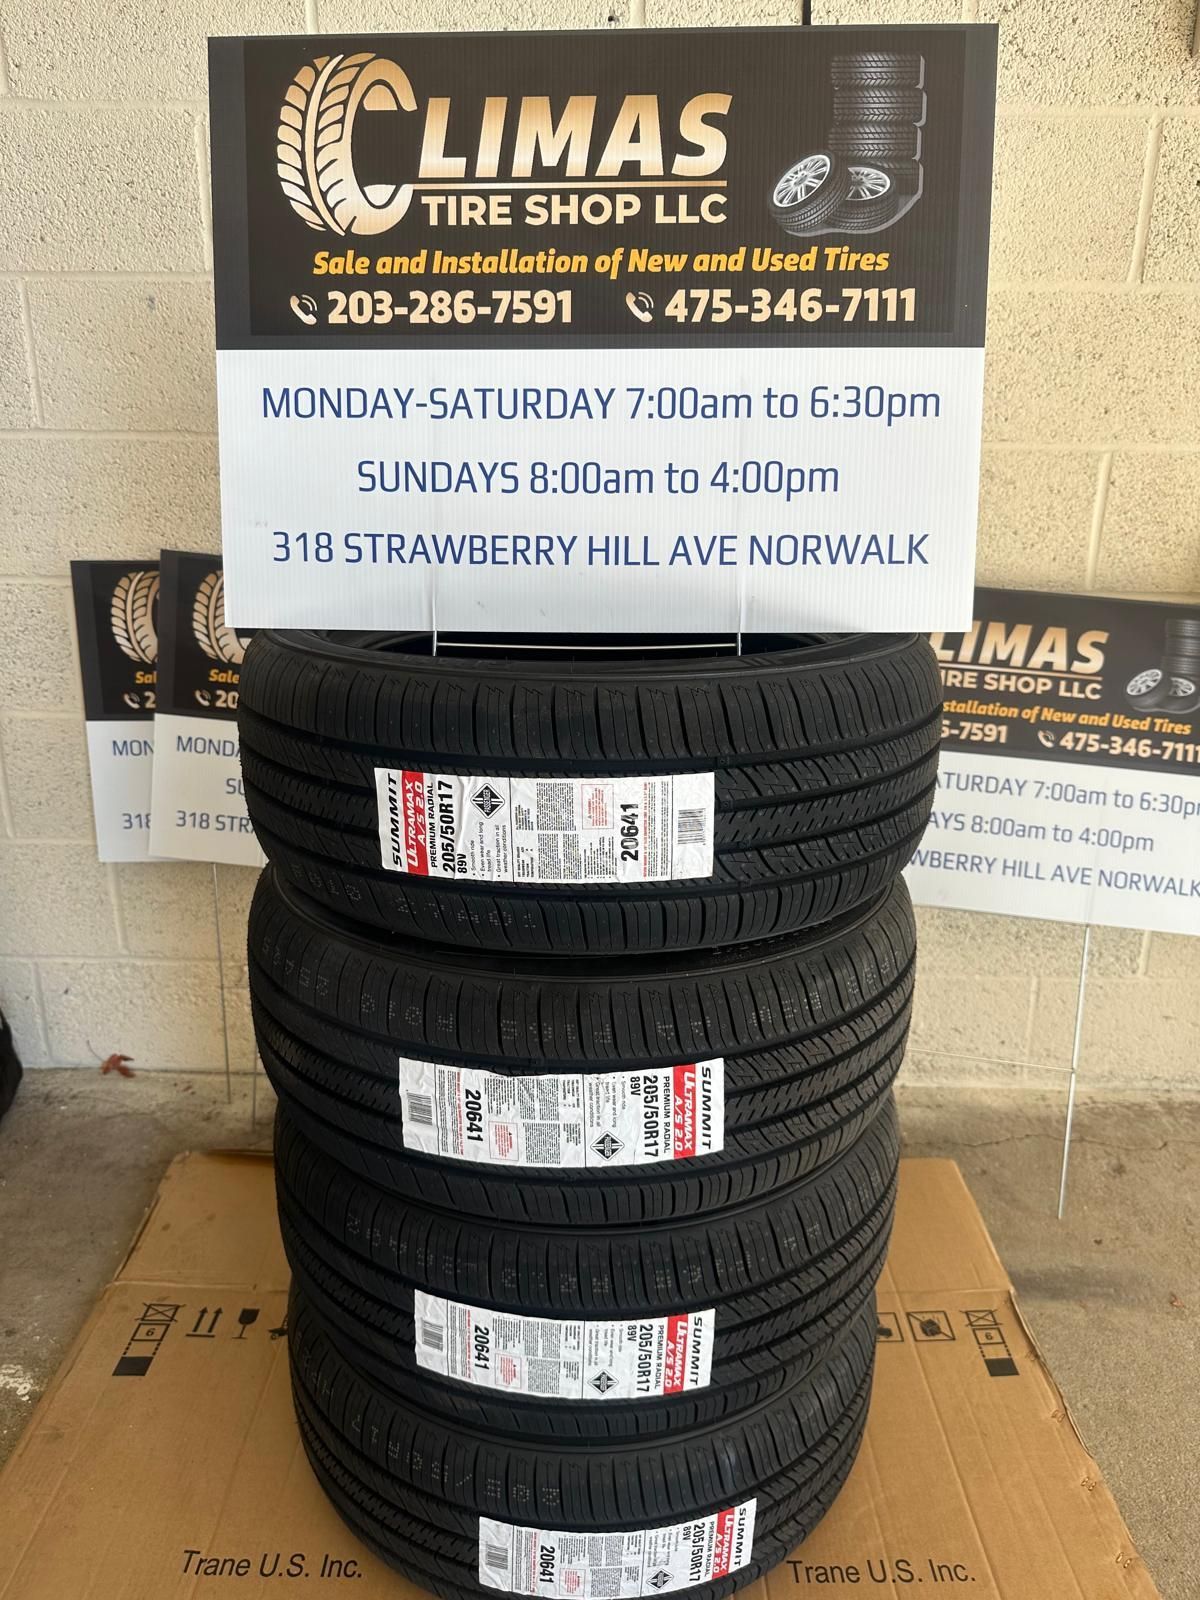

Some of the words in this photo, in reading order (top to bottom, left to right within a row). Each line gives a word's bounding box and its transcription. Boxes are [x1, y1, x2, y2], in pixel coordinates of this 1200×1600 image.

[276, 52, 733, 236] CLIMAS
[421, 194, 513, 226] TIRE
[524, 193, 642, 226] SHOP
[655, 193, 729, 225] LLC
[312, 249, 369, 277] Sale
[376, 248, 427, 276] and
[432, 247, 589, 275] Installation
[594, 246, 626, 281] of
[627, 246, 689, 273] New
[693, 245, 748, 272] and
[751, 245, 817, 272] Used
[823, 244, 891, 272] Tires
[327, 289, 573, 324] 203-286-7591
[664, 286, 917, 323] 475-346-7111
[261, 386, 617, 420] MONDAY-SATURDAY
[625, 386, 753, 420] 7:00am
[762, 387, 799, 419] to
[809, 384, 942, 427] 6:30pm
[357, 460, 520, 494] SUNDAYS
[529, 461, 654, 495] 8:00am
[663, 462, 700, 494] to
[710, 460, 840, 502] 4:00pm
[272, 531, 334, 563] 318
[343, 532, 578, 567] STRAWBERRY
[587, 534, 660, 566] HILL
[668, 534, 739, 566] AVE
[749, 532, 930, 567] NORWALK
[208, 668, 240, 684] Sale
[984, 673, 1053, 696] SHOP
[1058, 679, 1103, 700] LLC
[1021, 705, 1041, 724] of
[1040, 706, 1076, 726] New
[1078, 711, 1110, 728] and
[1110, 713, 1151, 732] Used
[1153, 718, 1192, 736] Tires
[414, 781, 424, 808] 2.0
[426, 782, 436, 820] RADIAL
[1033, 780, 1108, 808] 7:00am
[1113, 789, 1134, 809] to
[176, 810, 210, 830] 318
[387, 772, 403, 868] SUMMIT
[416, 814, 426, 847] A/S
[438, 780, 456, 873] 205/50R17
[620, 803, 639, 862] 20641
[970, 815, 1046, 841] 8:00am
[1052, 822, 1073, 844] to
[1078, 827, 1155, 853] 4:00pm
[428, 822, 438, 869] PREMIUM
[457, 853, 468, 874] 89V
[1001, 858, 1046, 881] HILL
[1050, 863, 1094, 886] AVE
[1097, 869, 1200, 898] NORWALK
[630, 1076, 641, 1096] 89V
[663, 1075, 671, 1119] PREMIUM
[465, 1088, 484, 1143] 20641
[643, 1074, 659, 1158] 205/50R17
[674, 1095, 683, 1125] A/S
[701, 1066, 712, 1150] SUMMIT
[663, 1121, 671, 1154] RADIAL
[674, 1129, 683, 1151] 2.0
[146, 1327, 156, 1337] 6
[474, 1324, 490, 1370] 20641
[627, 1324, 637, 1342] 89V
[656, 1324, 665, 1361] PREMIUM
[985, 1332, 993, 1341] 6
[636, 1323, 654, 1393] 205/50R17
[665, 1340, 675, 1368] A/S
[689, 1316, 703, 1386] SUMMIT
[654, 1362, 662, 1390] RADIAL
[664, 1370, 673, 1388] 2.0
[682, 1525, 692, 1541] 89V
[707, 1520, 715, 1553] PREMIUM
[734, 1507, 747, 1567] SUMMIT
[183, 1549, 251, 1577] Trane
[259, 1552, 311, 1578] U.S.
[320, 1553, 363, 1578] Inc.
[539, 1544, 556, 1584] 20641
[689, 1521, 706, 1582] 205/50R17
[713, 1557, 721, 1573] 2.0
[786, 1559, 860, 1584] Trane
[866, 1558, 923, 1584] U.S.
[928, 1558, 976, 1582] Inc.
